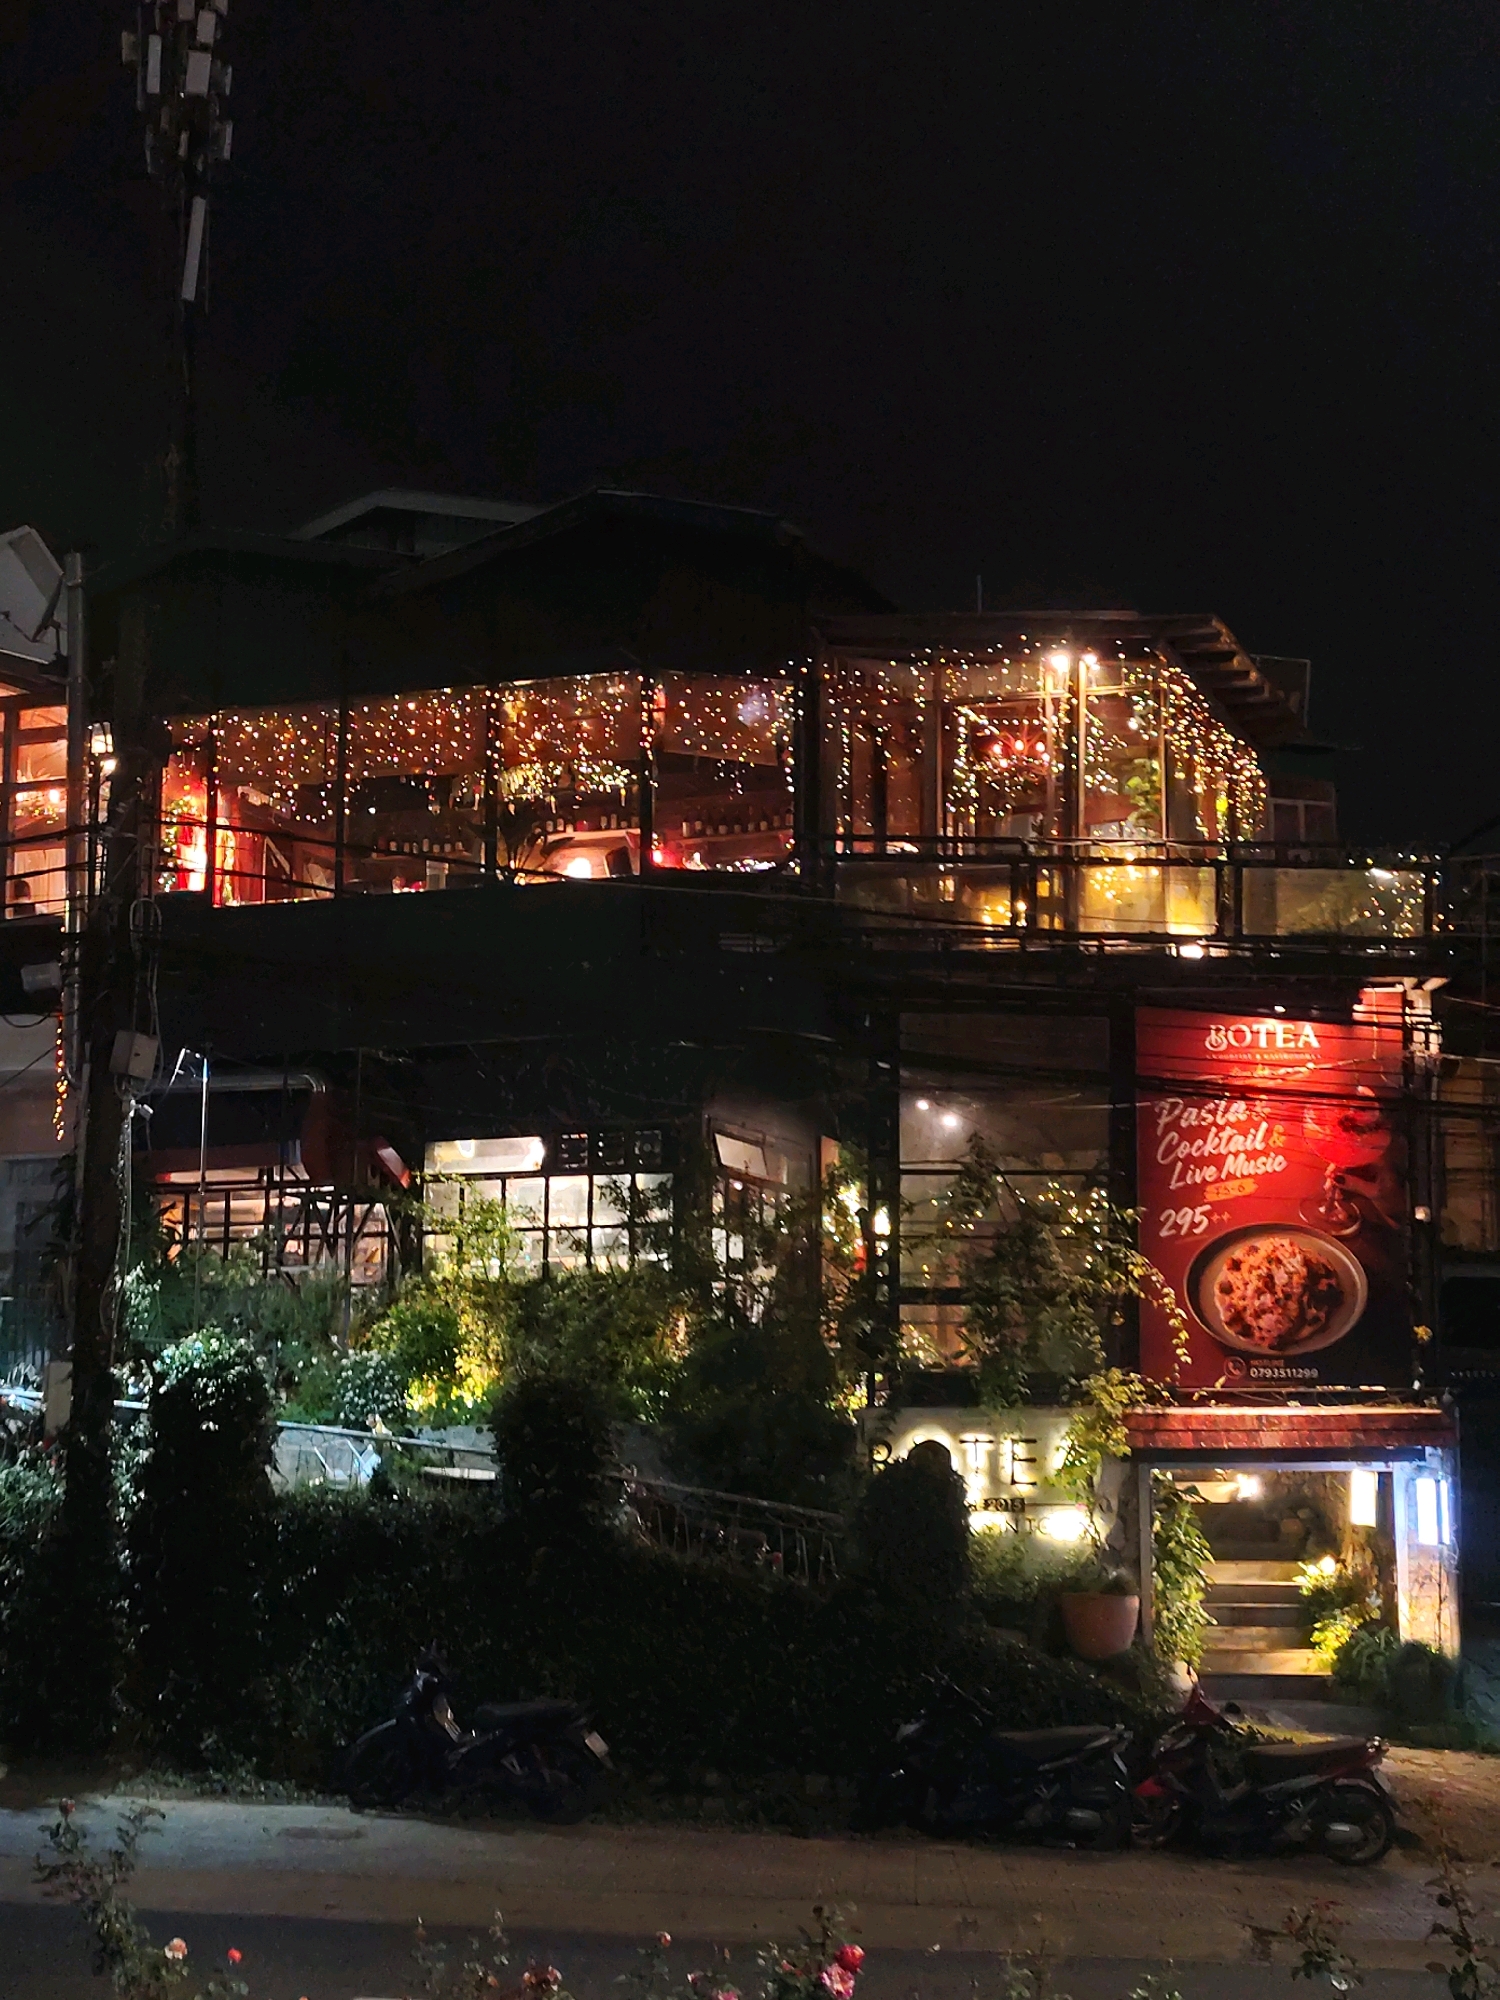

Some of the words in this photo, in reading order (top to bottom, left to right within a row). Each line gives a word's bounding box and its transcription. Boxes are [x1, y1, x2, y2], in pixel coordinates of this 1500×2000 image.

[1205, 1023, 1321, 1052] BOTEA
[1154, 1097, 1249, 1136] Pasta
[1156, 1121, 1269, 1165] Cocktail
[1268, 1124, 1287, 1148] &
[1169, 1160, 1220, 1190] Live
[1220, 1151, 1288, 1180] Music
